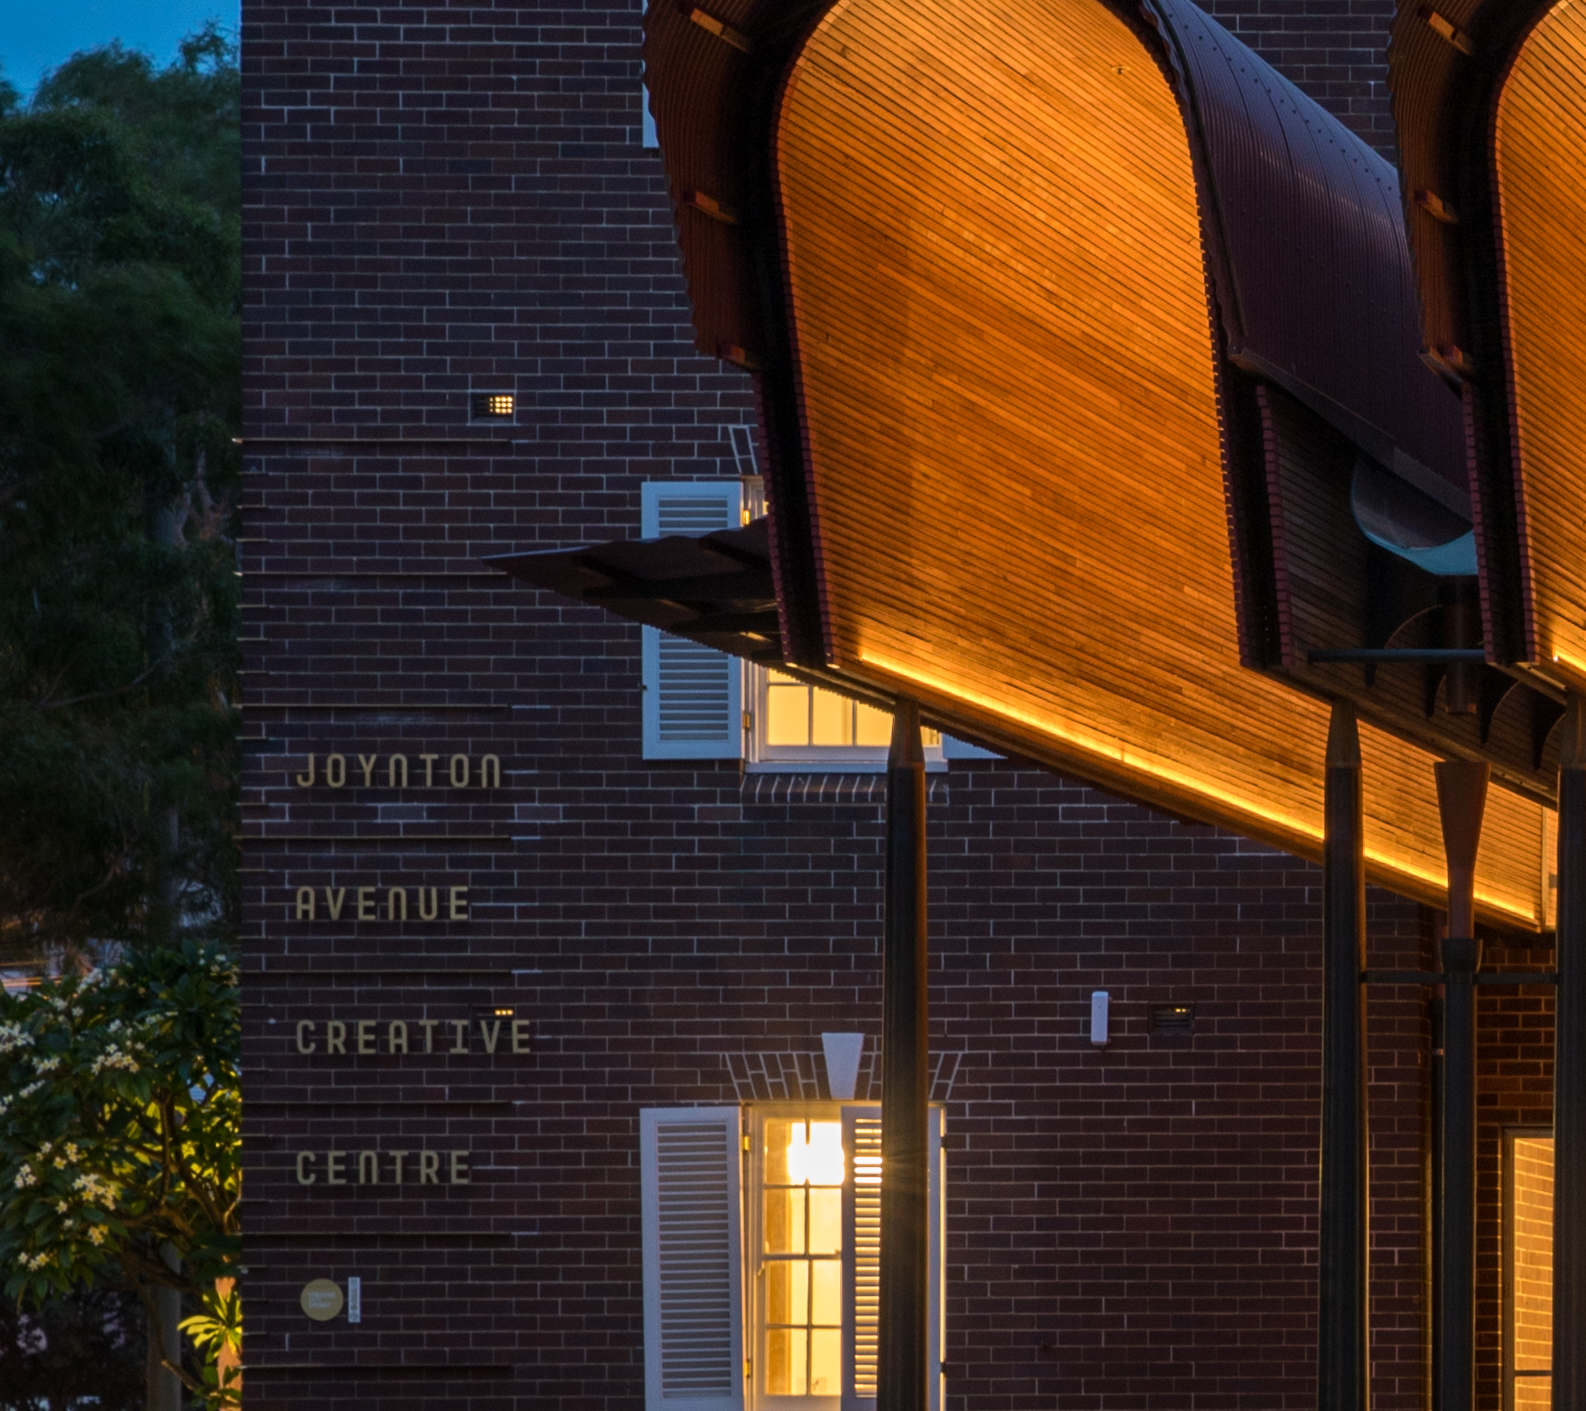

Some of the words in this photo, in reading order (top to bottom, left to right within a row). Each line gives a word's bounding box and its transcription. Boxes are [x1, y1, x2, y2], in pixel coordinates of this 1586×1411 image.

[295, 753, 502, 789] JOYNTON
[295, 886, 470, 922] AVENUE
[295, 1020, 531, 1055] CREATIVE
[295, 1150, 470, 1186] CENTRE
